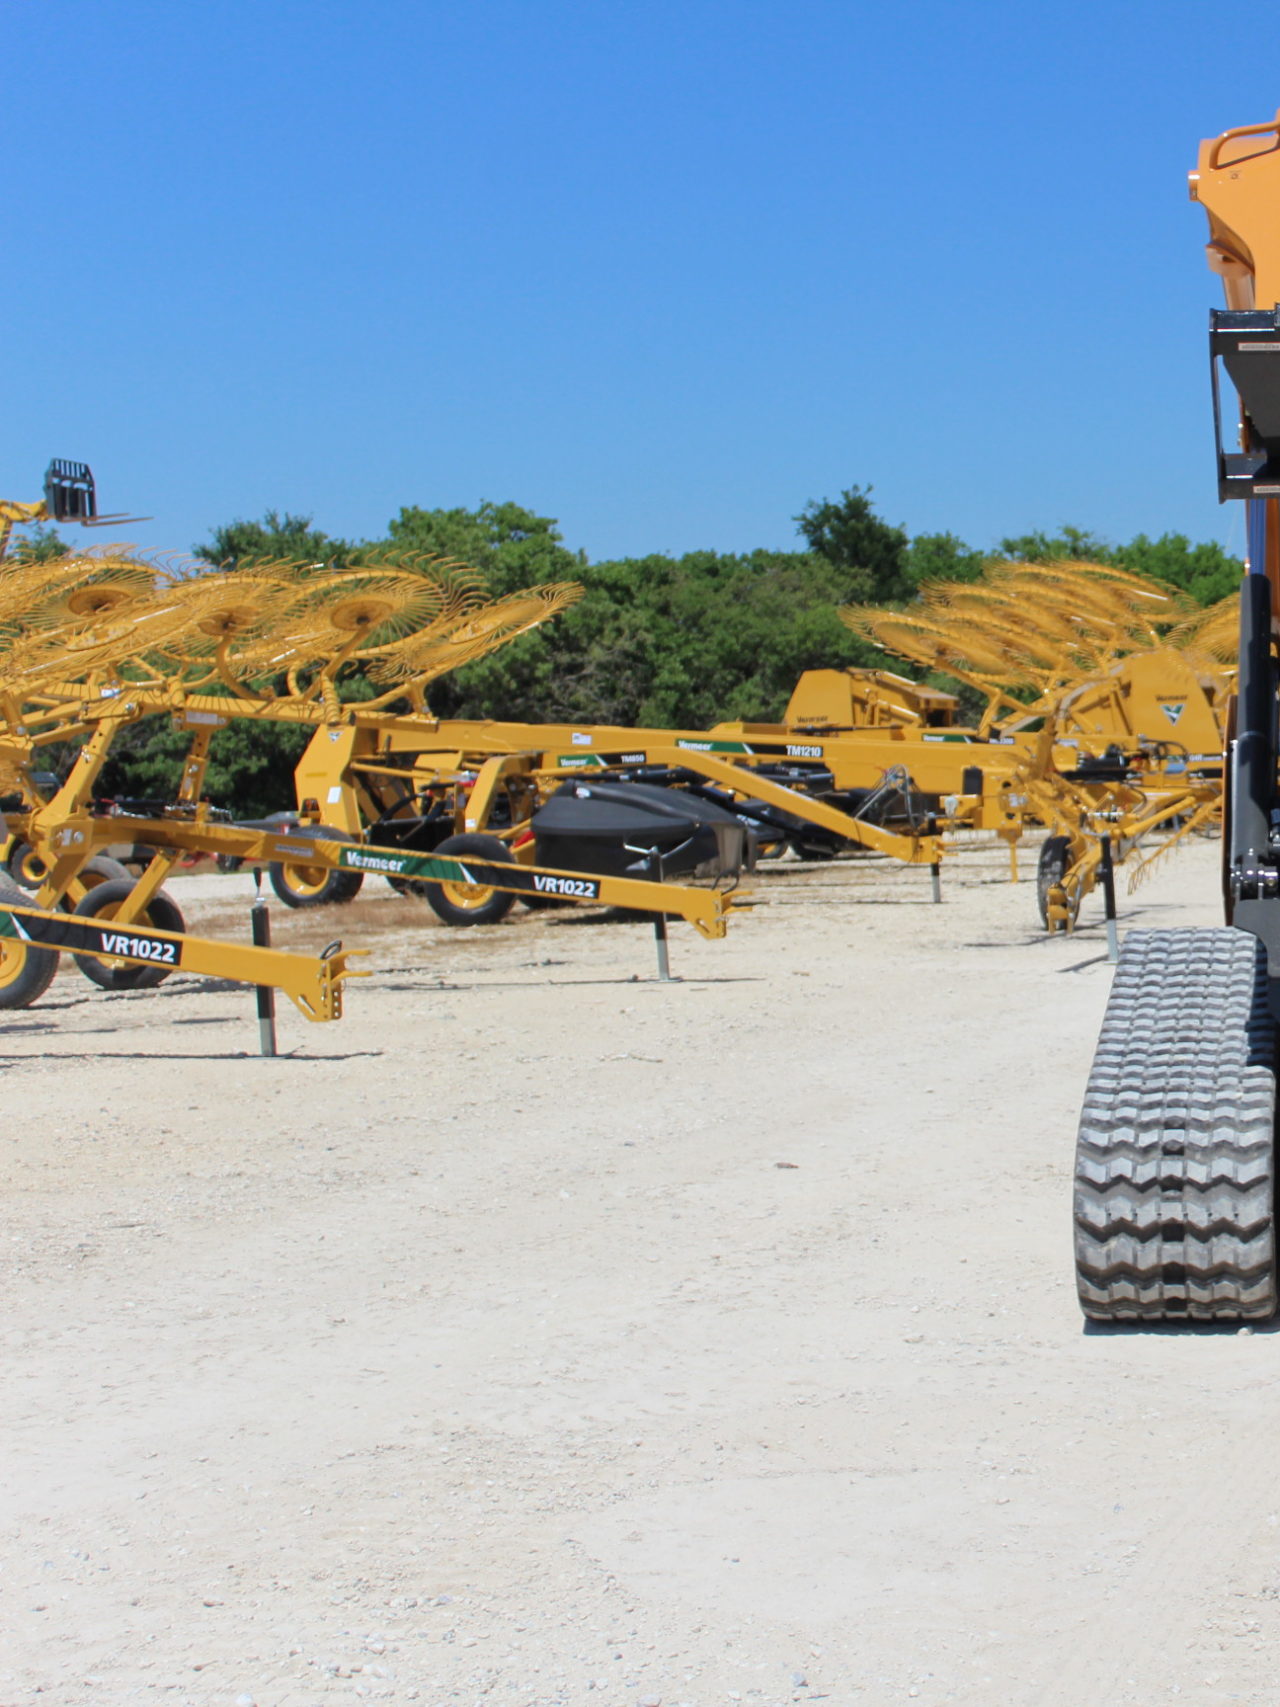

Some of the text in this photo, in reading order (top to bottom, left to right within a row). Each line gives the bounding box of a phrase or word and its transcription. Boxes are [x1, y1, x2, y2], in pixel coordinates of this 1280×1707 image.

[786, 745, 821, 757] TM1210
[346, 851, 596, 898] Vermeer VR1022
[101, 932, 176, 963] VR1022
